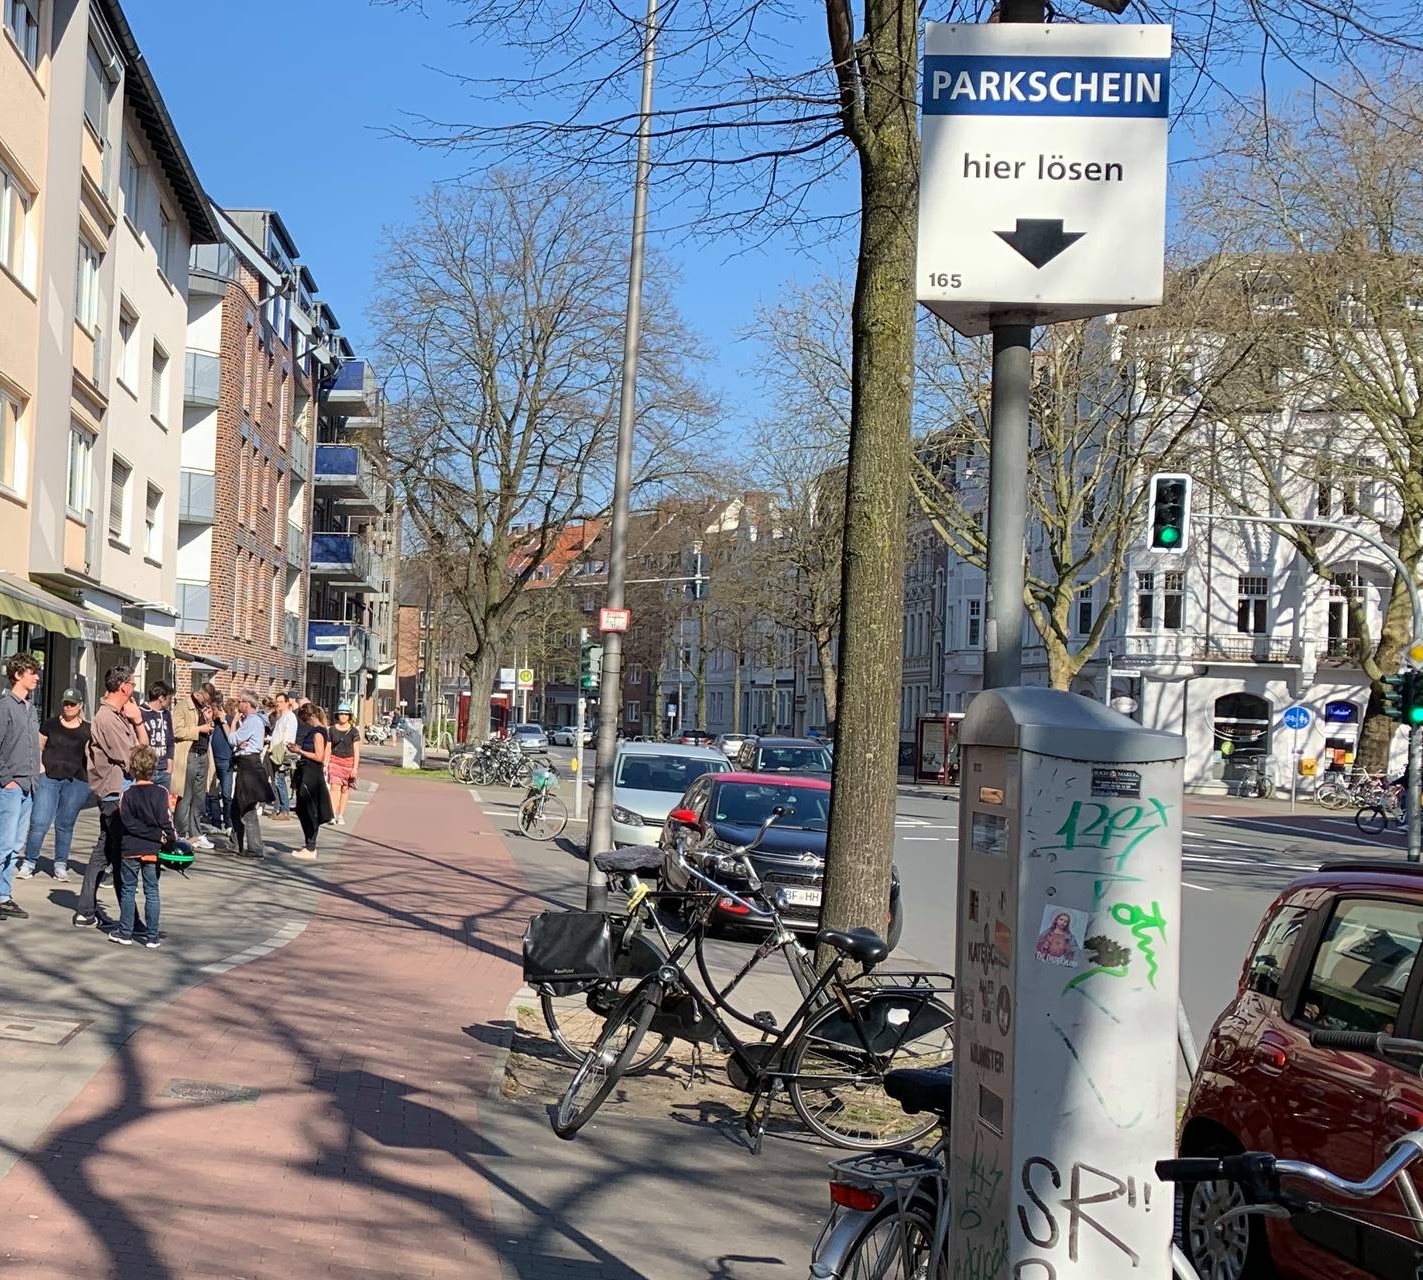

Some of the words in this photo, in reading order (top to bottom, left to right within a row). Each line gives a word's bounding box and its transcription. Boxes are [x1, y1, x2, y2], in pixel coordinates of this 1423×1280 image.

[932, 70, 1161, 103] PARKSCHEIN
[964, 153, 1026, 180] hier
[1037, 154, 1124, 182] lösen
[928, 272, 962, 289] 165
